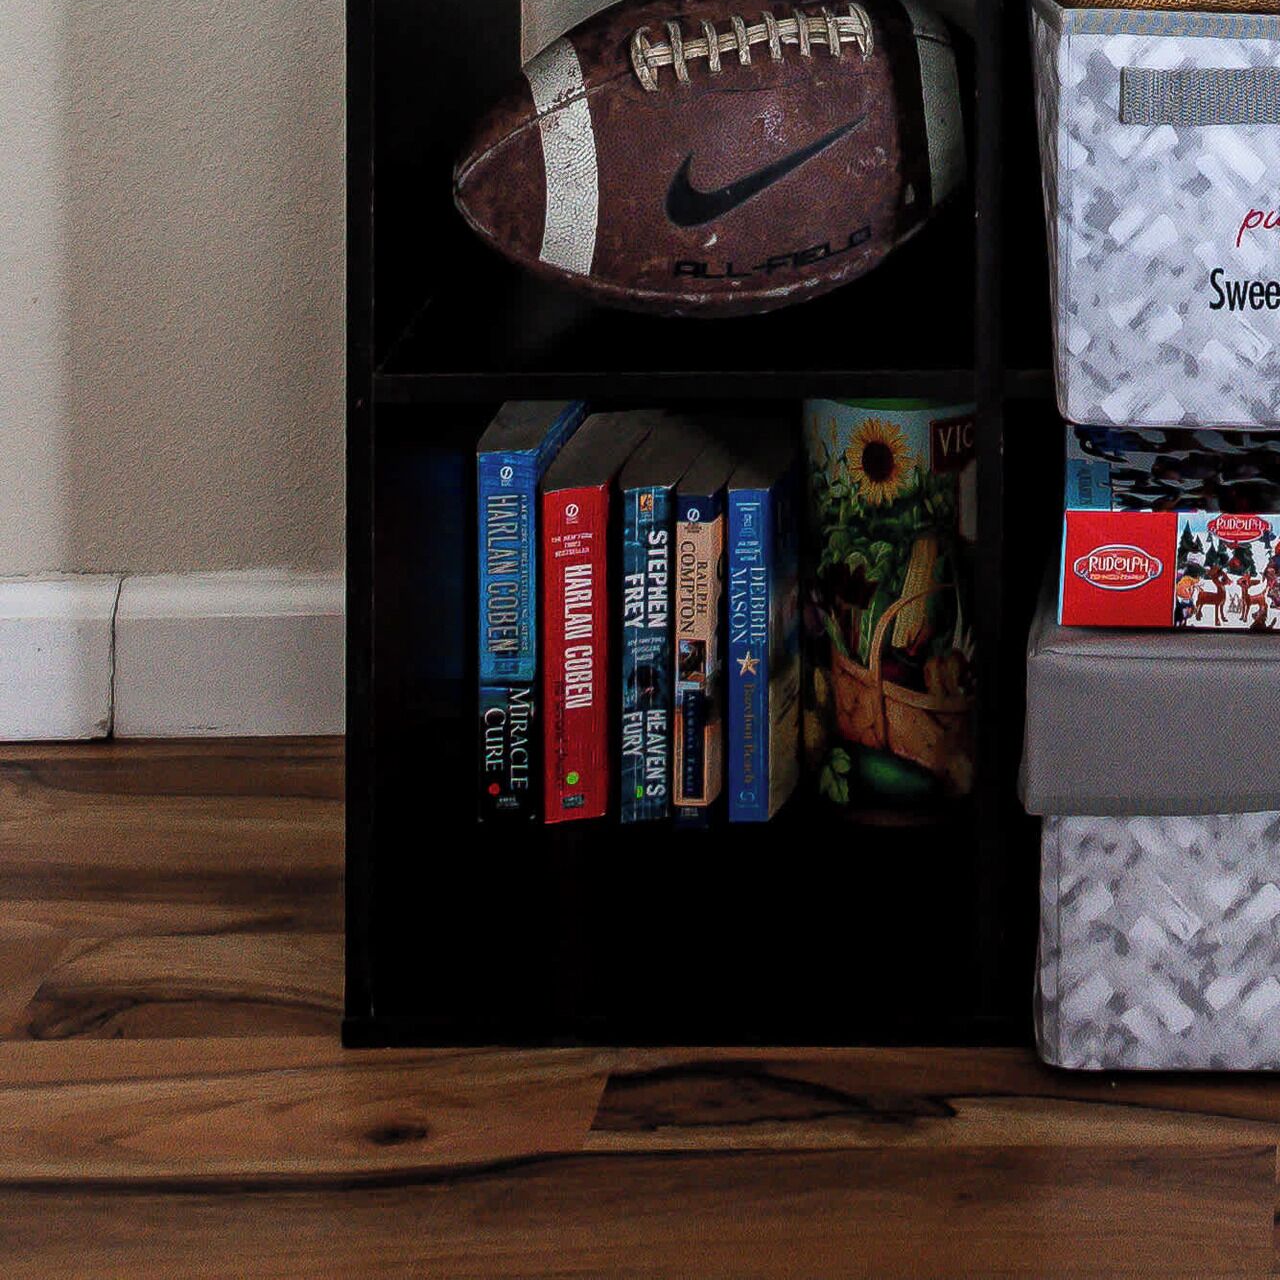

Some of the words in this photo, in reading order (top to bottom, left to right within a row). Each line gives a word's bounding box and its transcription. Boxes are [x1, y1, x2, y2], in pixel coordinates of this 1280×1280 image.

[487, 494, 519, 575] HARLAN
[1216, 516, 1262, 531] RUDOLPH
[564, 563, 593, 640] HARLAN
[624, 572, 645, 628] FREY
[647, 529, 668, 628] STEPHEN
[680, 540, 696, 634] COMPTON
[697, 561, 708, 614] RALPH
[1088, 555, 1150, 574] RUDOLPH
[487, 581, 519, 653] COBEN
[731, 567, 748, 644] MASON
[750, 567, 767, 644] DEBBIE
[564, 644, 593, 709] COBEN
[484, 707, 506, 772] CURE
[509, 687, 530, 791] MIRACLE
[622, 711, 644, 756] FURY
[646, 708, 668, 797] HEAVEN'S
